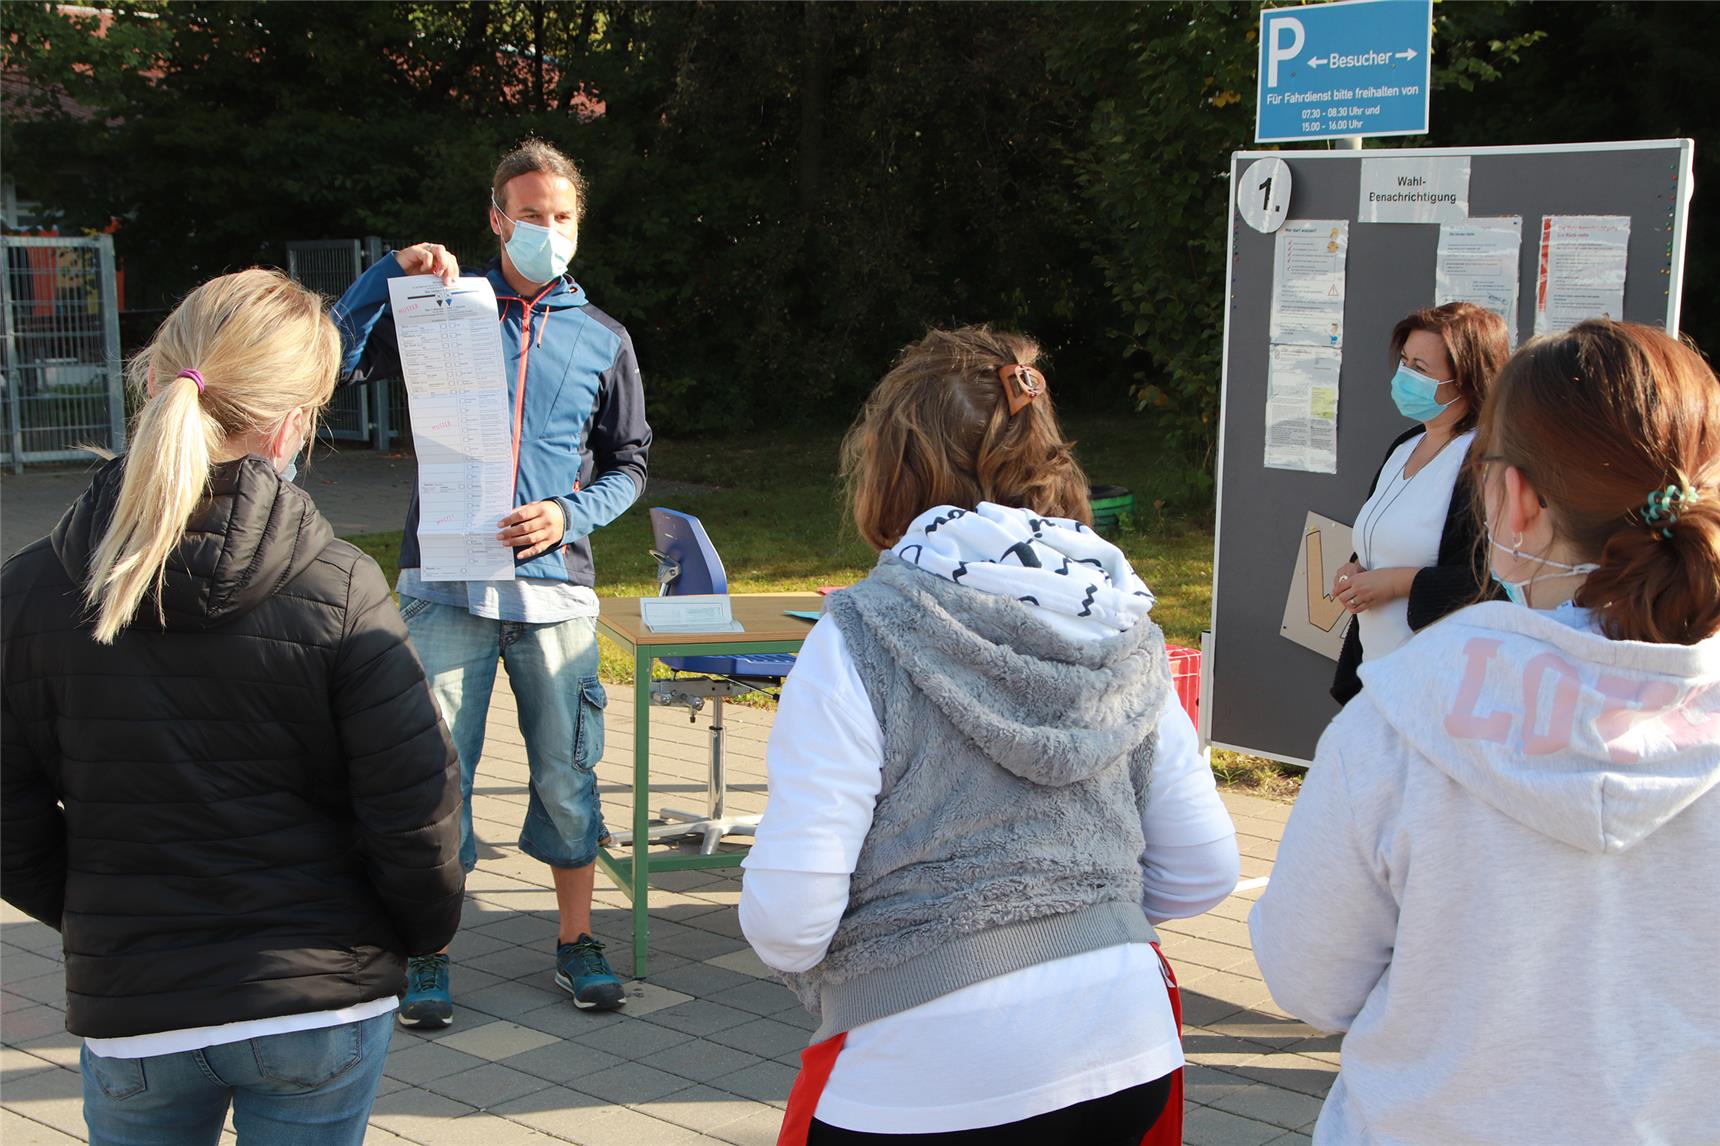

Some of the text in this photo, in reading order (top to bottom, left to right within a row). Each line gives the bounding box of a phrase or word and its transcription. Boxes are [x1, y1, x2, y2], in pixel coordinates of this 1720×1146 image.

[1267, 17, 1306, 88] P
[1329, 51, 1393, 69] Besucher
[1267, 86, 1419, 105] Für Fahrdienst bitte freihalten von
[1328, 107, 1348, 117] 08.30
[1349, 106, 1364, 116] Uhr
[1365, 105, 1380, 115] und
[1302, 122, 1320, 132] 15.00
[1328, 121, 1348, 131] 16.00
[1349, 120, 1364, 129] Uhr
[1397, 176, 1426, 187] Wahl-
[1258, 177, 1281, 212] 1.
[1369, 192, 1457, 204] Benachrichtigung
